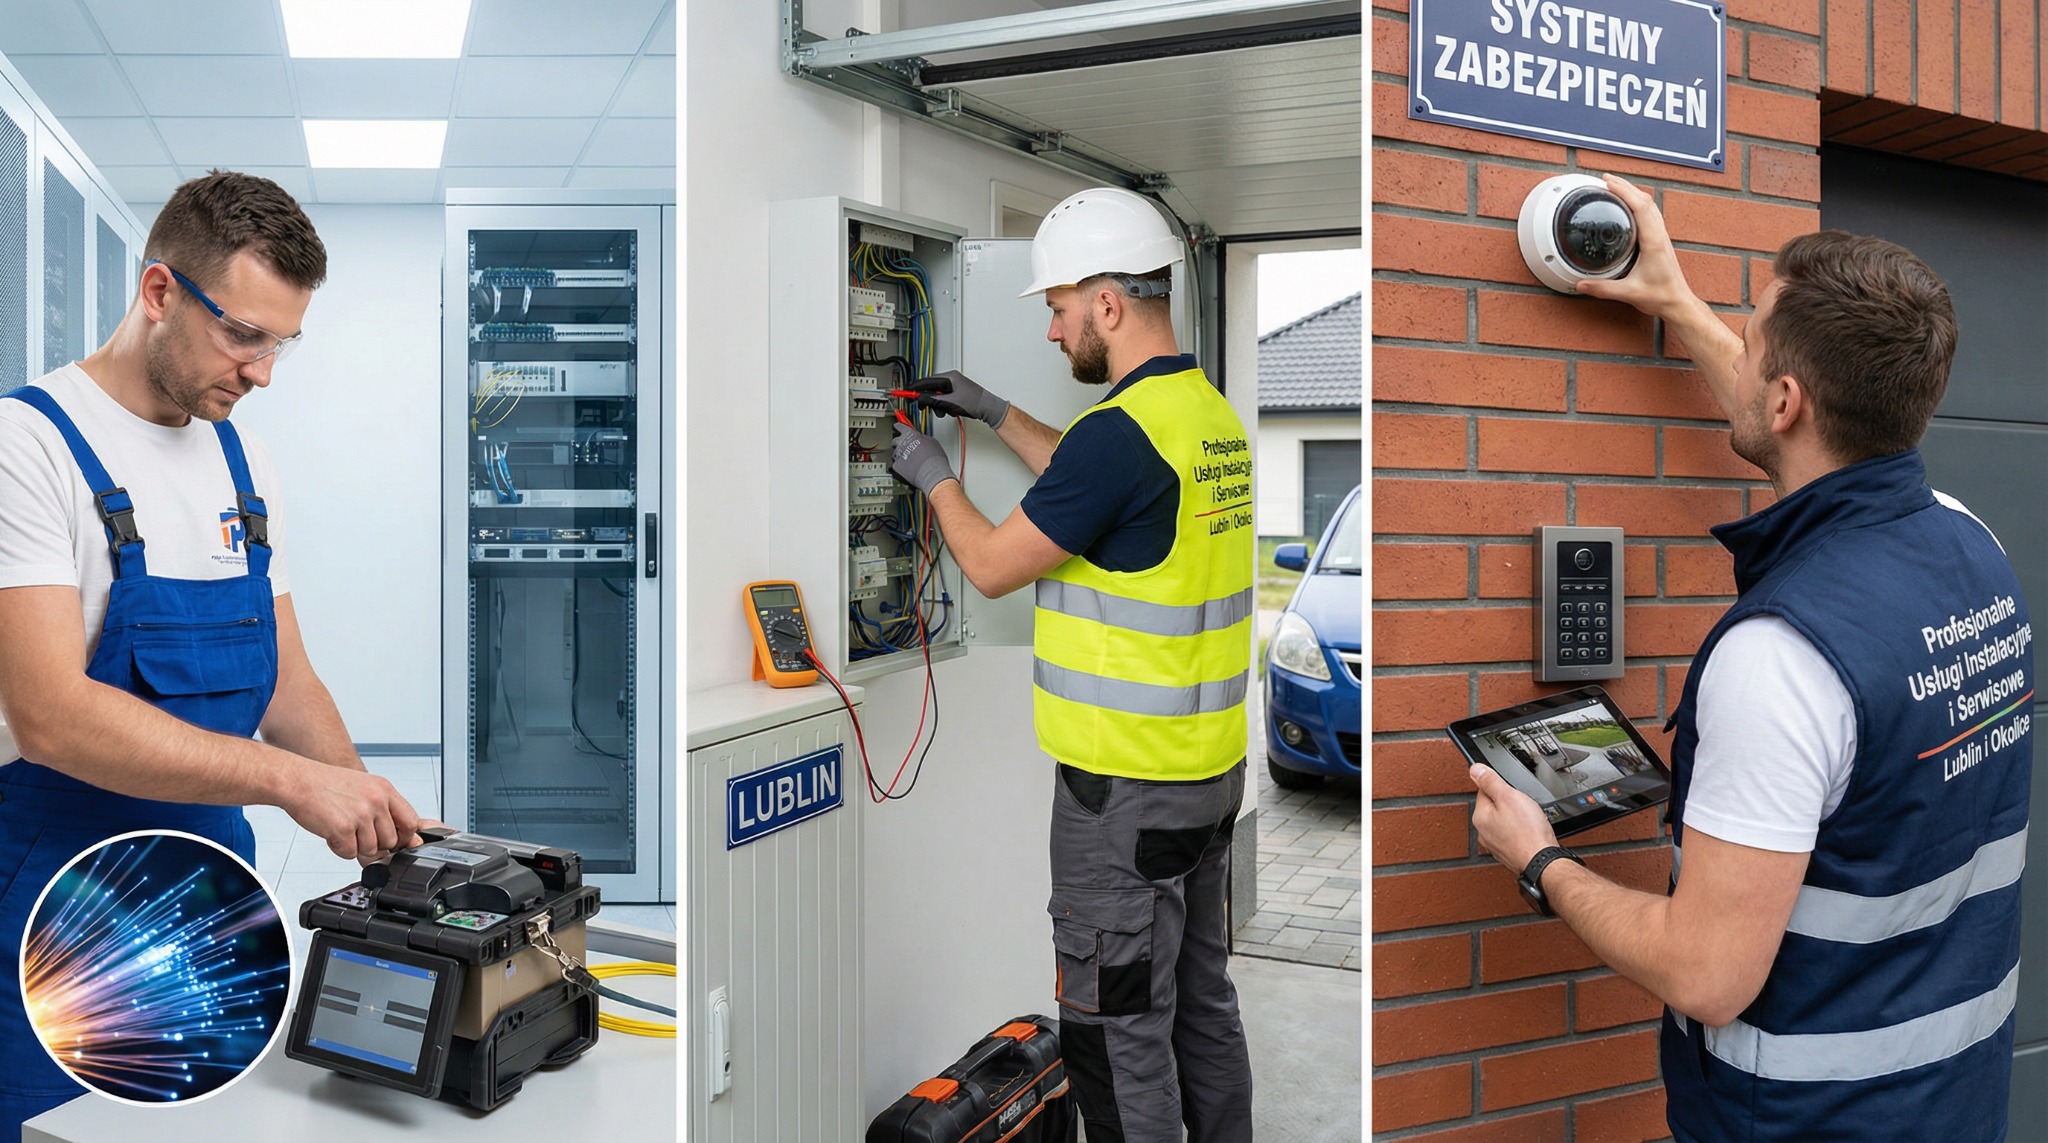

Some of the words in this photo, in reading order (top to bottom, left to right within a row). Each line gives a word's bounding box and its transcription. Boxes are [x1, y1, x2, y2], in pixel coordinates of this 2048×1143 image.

[1490, 0, 1664, 66] SYSTEMY
[1433, 34, 1708, 129] ZABEZPIECZEŃ
[1212, 487, 1216, 503] i
[1921, 594, 2016, 654] Profesjonalne
[1907, 655, 1965, 702] Usługi
[1963, 622, 2032, 678] Instalacyjne
[1948, 700, 1955, 727] i
[1958, 668, 2025, 722] Serwisowe
[1943, 741, 1983, 783] Lublin
[1984, 733, 1989, 758] i
[1990, 714, 2030, 753] Okolice
[738, 760, 836, 830] LUBLIN
